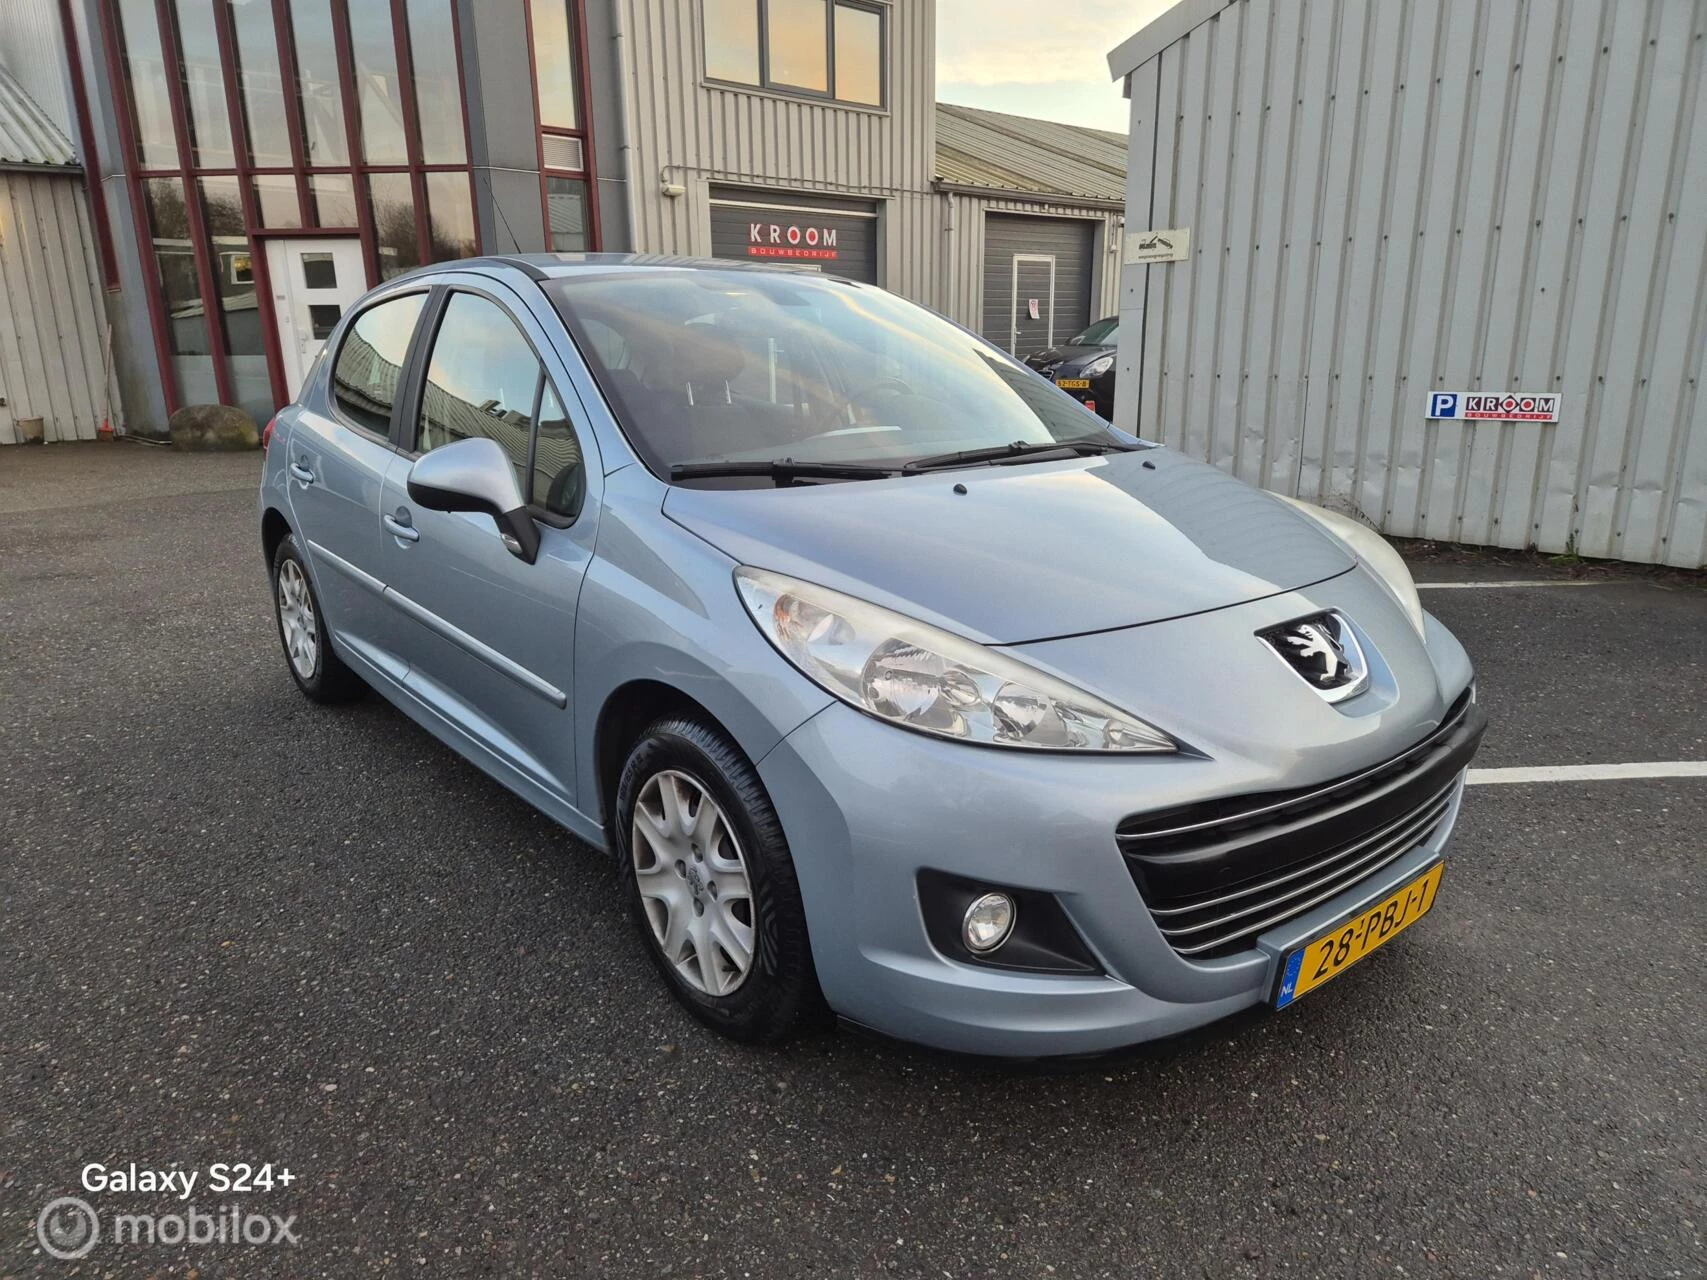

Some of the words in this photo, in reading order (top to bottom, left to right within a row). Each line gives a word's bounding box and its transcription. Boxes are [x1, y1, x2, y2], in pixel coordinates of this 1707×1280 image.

[750, 223, 836, 246] KROOM
[750, 246, 837, 258] BOUWBEDRIJF
[1434, 395, 1454, 417] P
[1466, 397, 1555, 412] KROOM
[1312, 878, 1429, 981] 28-PBJ-1
[1280, 983, 1293, 996] NL
